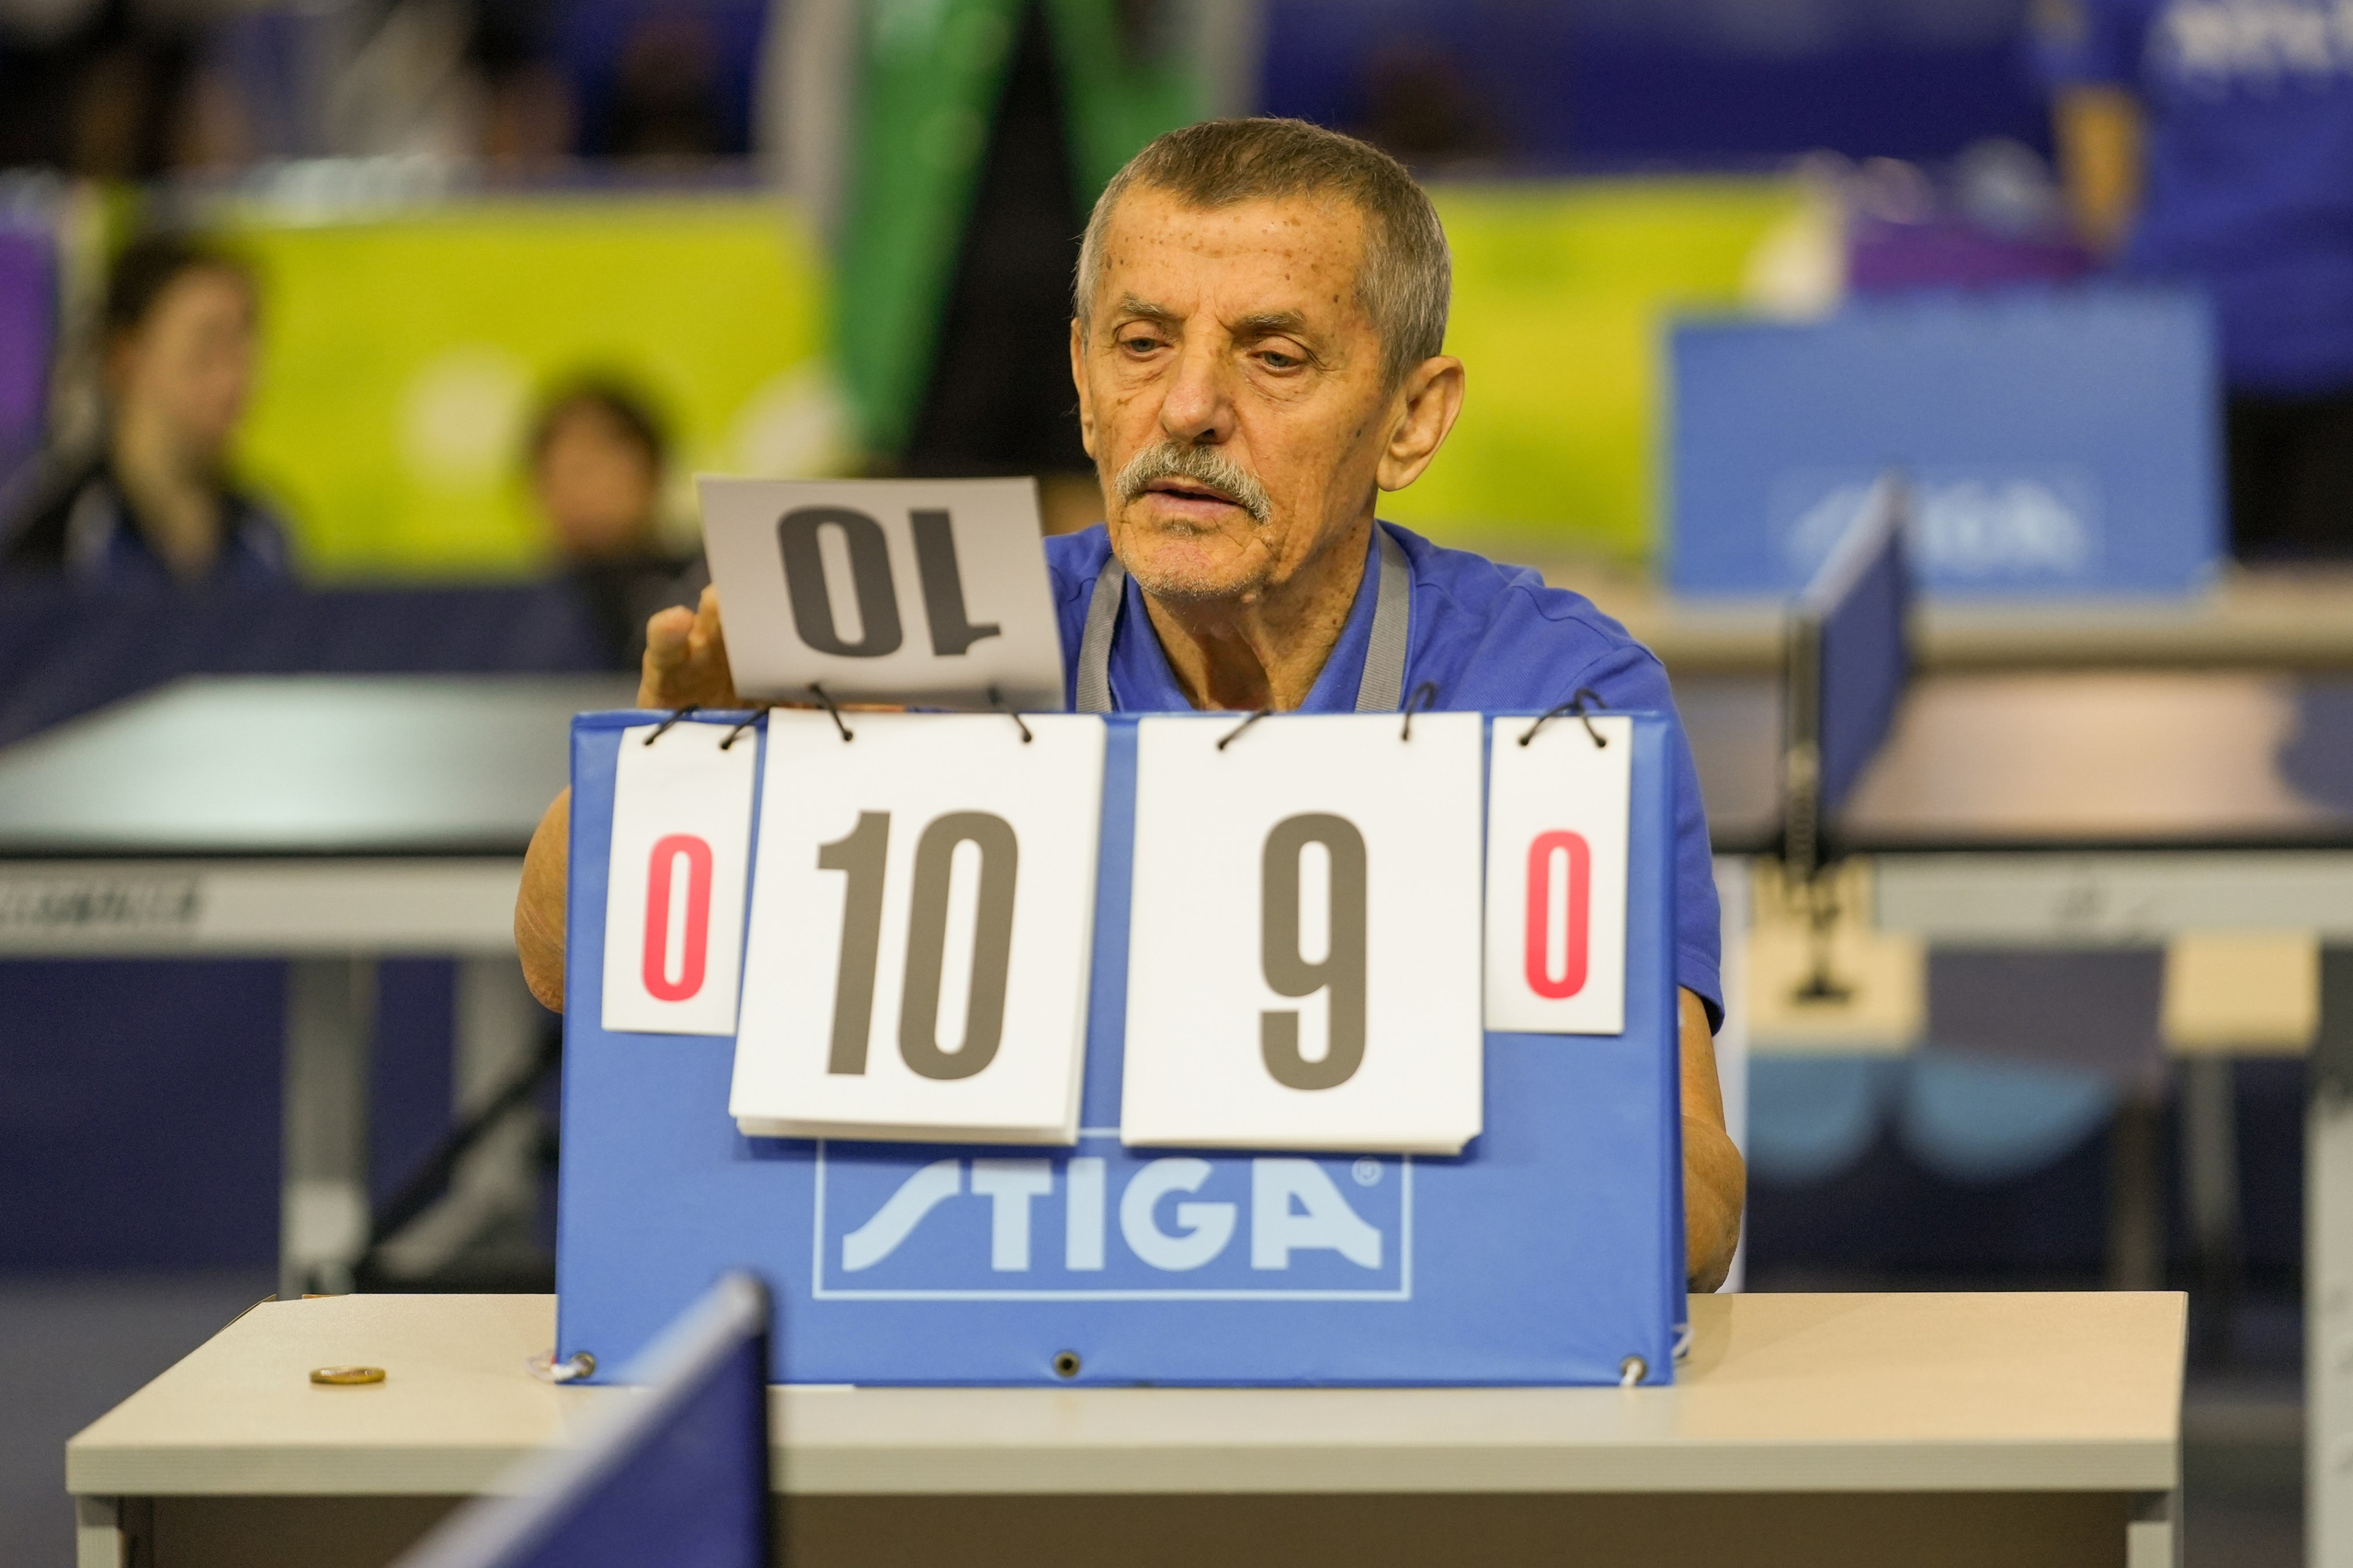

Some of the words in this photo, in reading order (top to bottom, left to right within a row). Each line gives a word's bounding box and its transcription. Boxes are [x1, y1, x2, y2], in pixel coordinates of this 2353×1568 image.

[776, 506, 1002, 659] 10
[642, 834, 713, 1003] 0
[817, 811, 1019, 1081] 10
[1261, 812, 1368, 1091] 9
[1523, 830, 1592, 1001] 0
[842, 1156, 1383, 1272] STIGA
